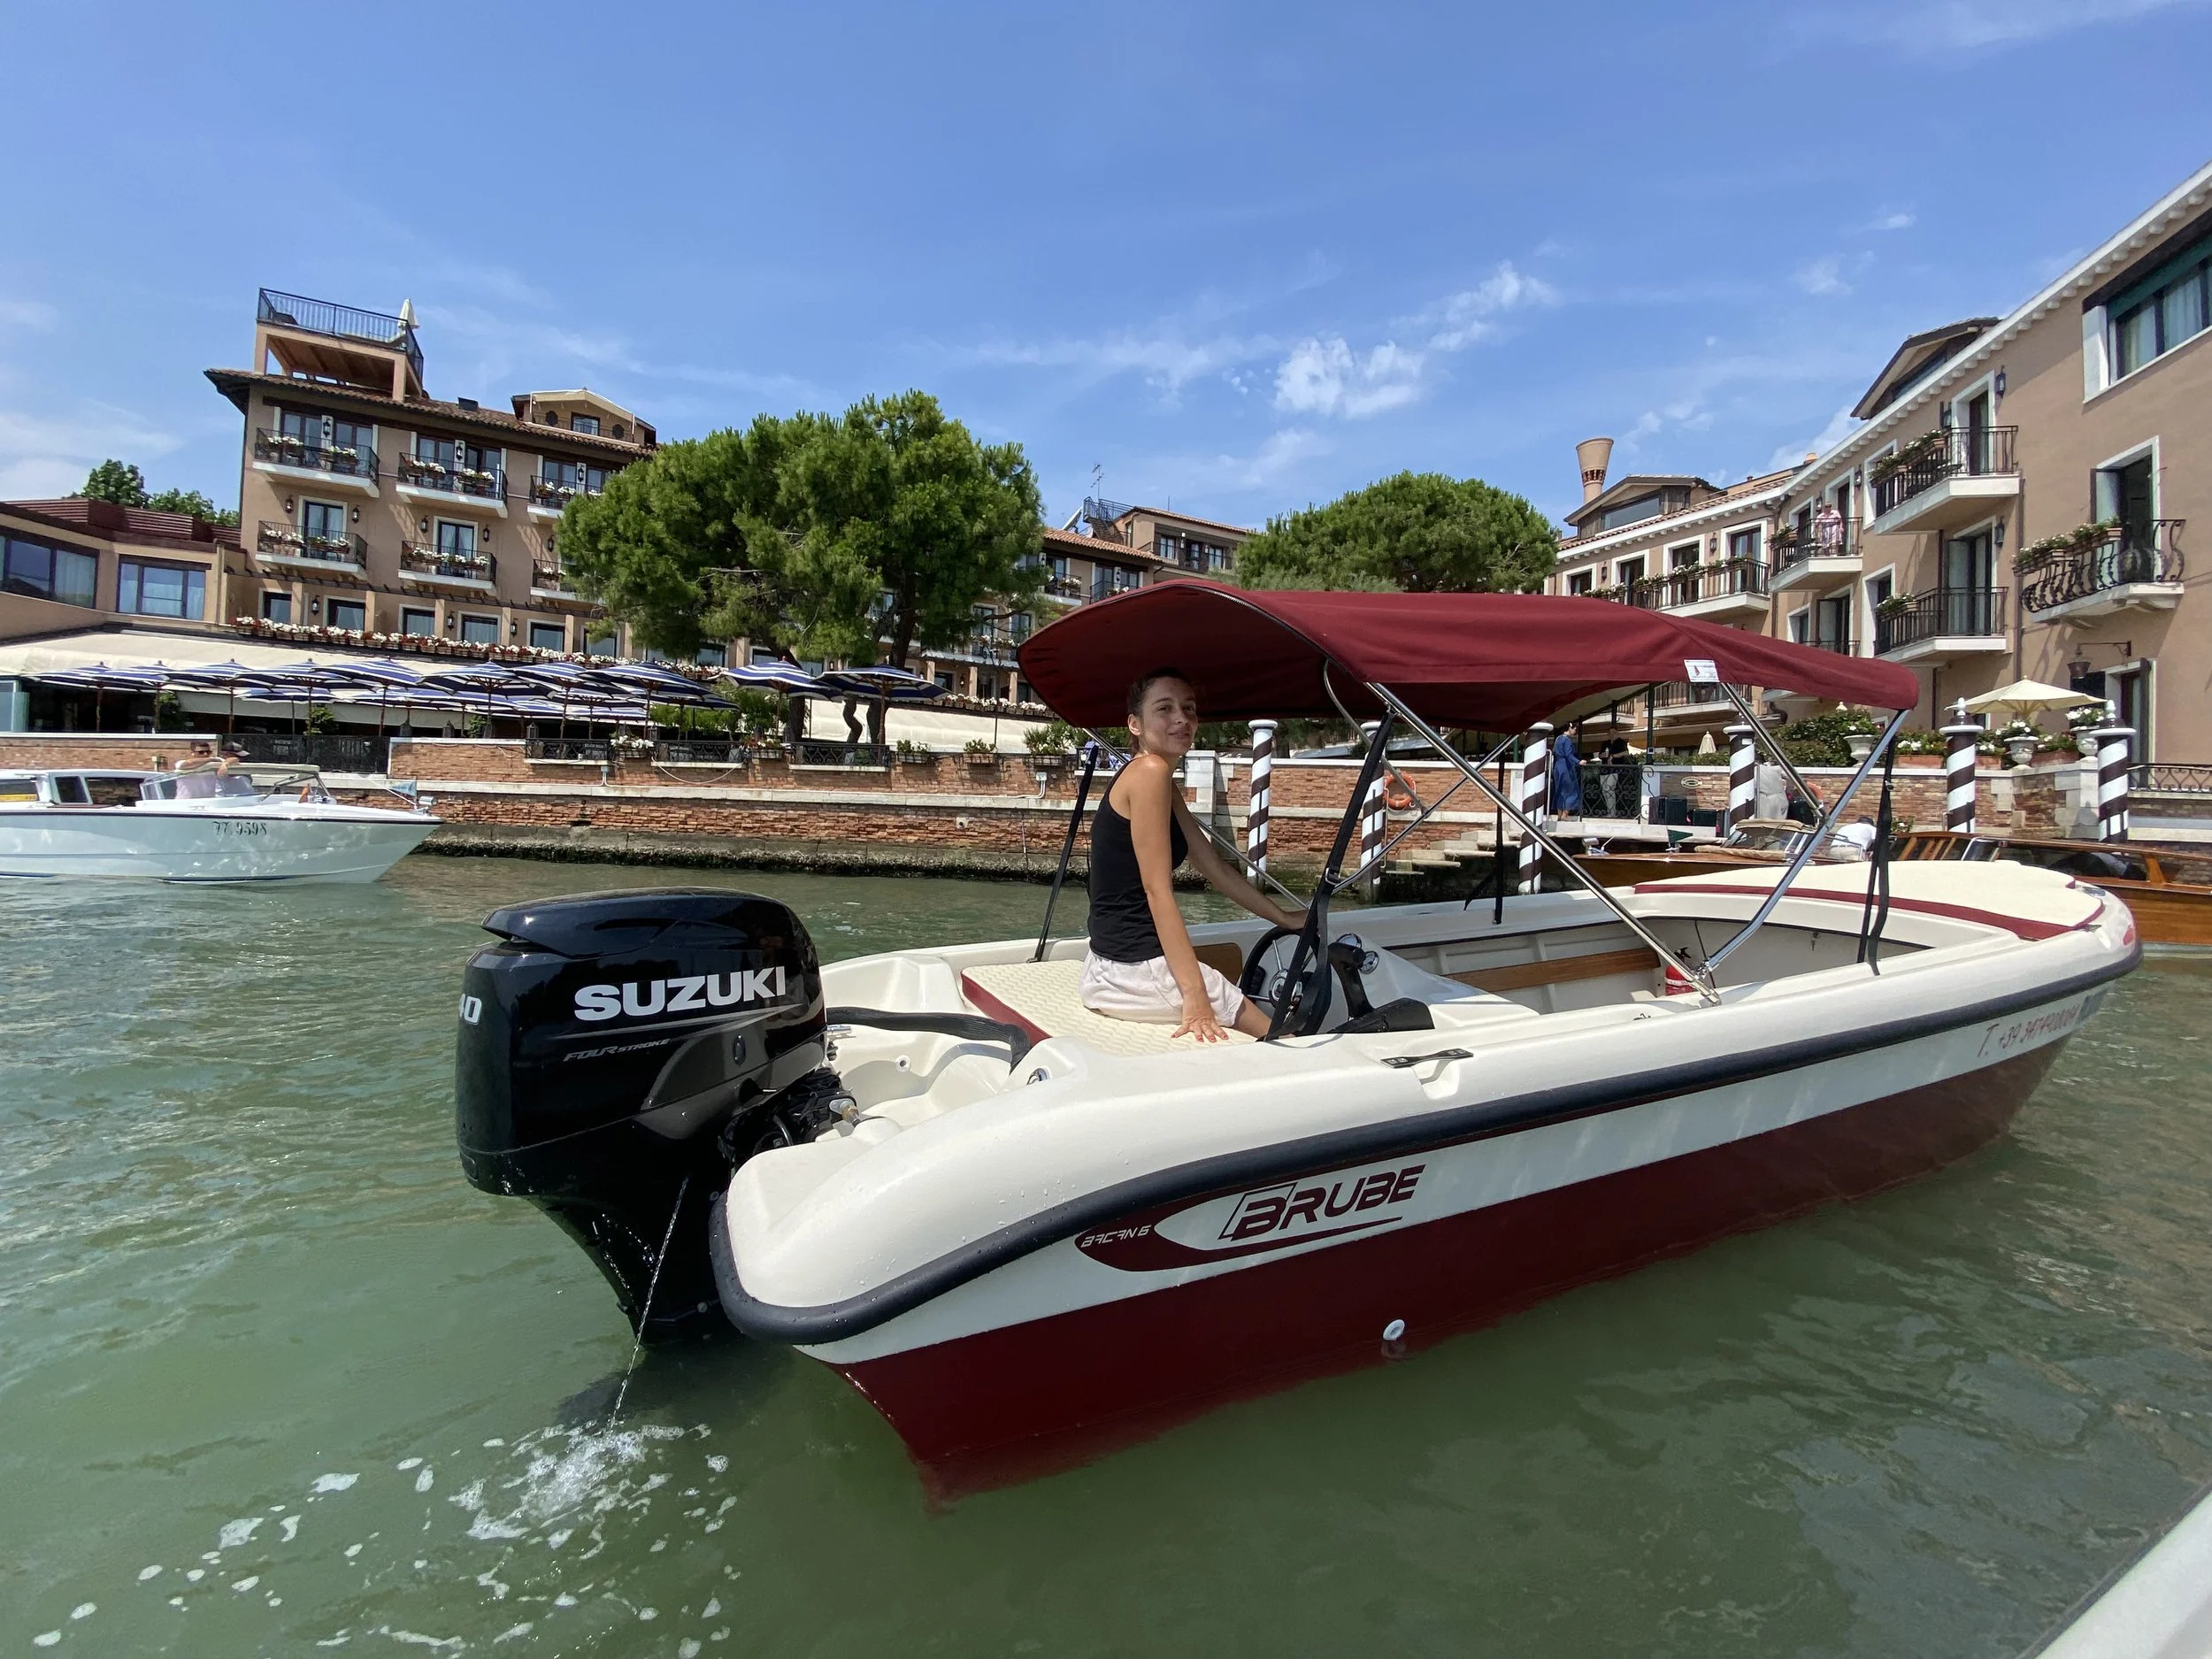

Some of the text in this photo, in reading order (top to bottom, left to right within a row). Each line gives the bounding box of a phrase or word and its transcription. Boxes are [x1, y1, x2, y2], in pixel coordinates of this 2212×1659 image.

[574, 966, 787, 1021] SUZUKI
[1228, 1164, 1426, 1241] BRUBE
[1137, 1225, 1152, 1237] 6
